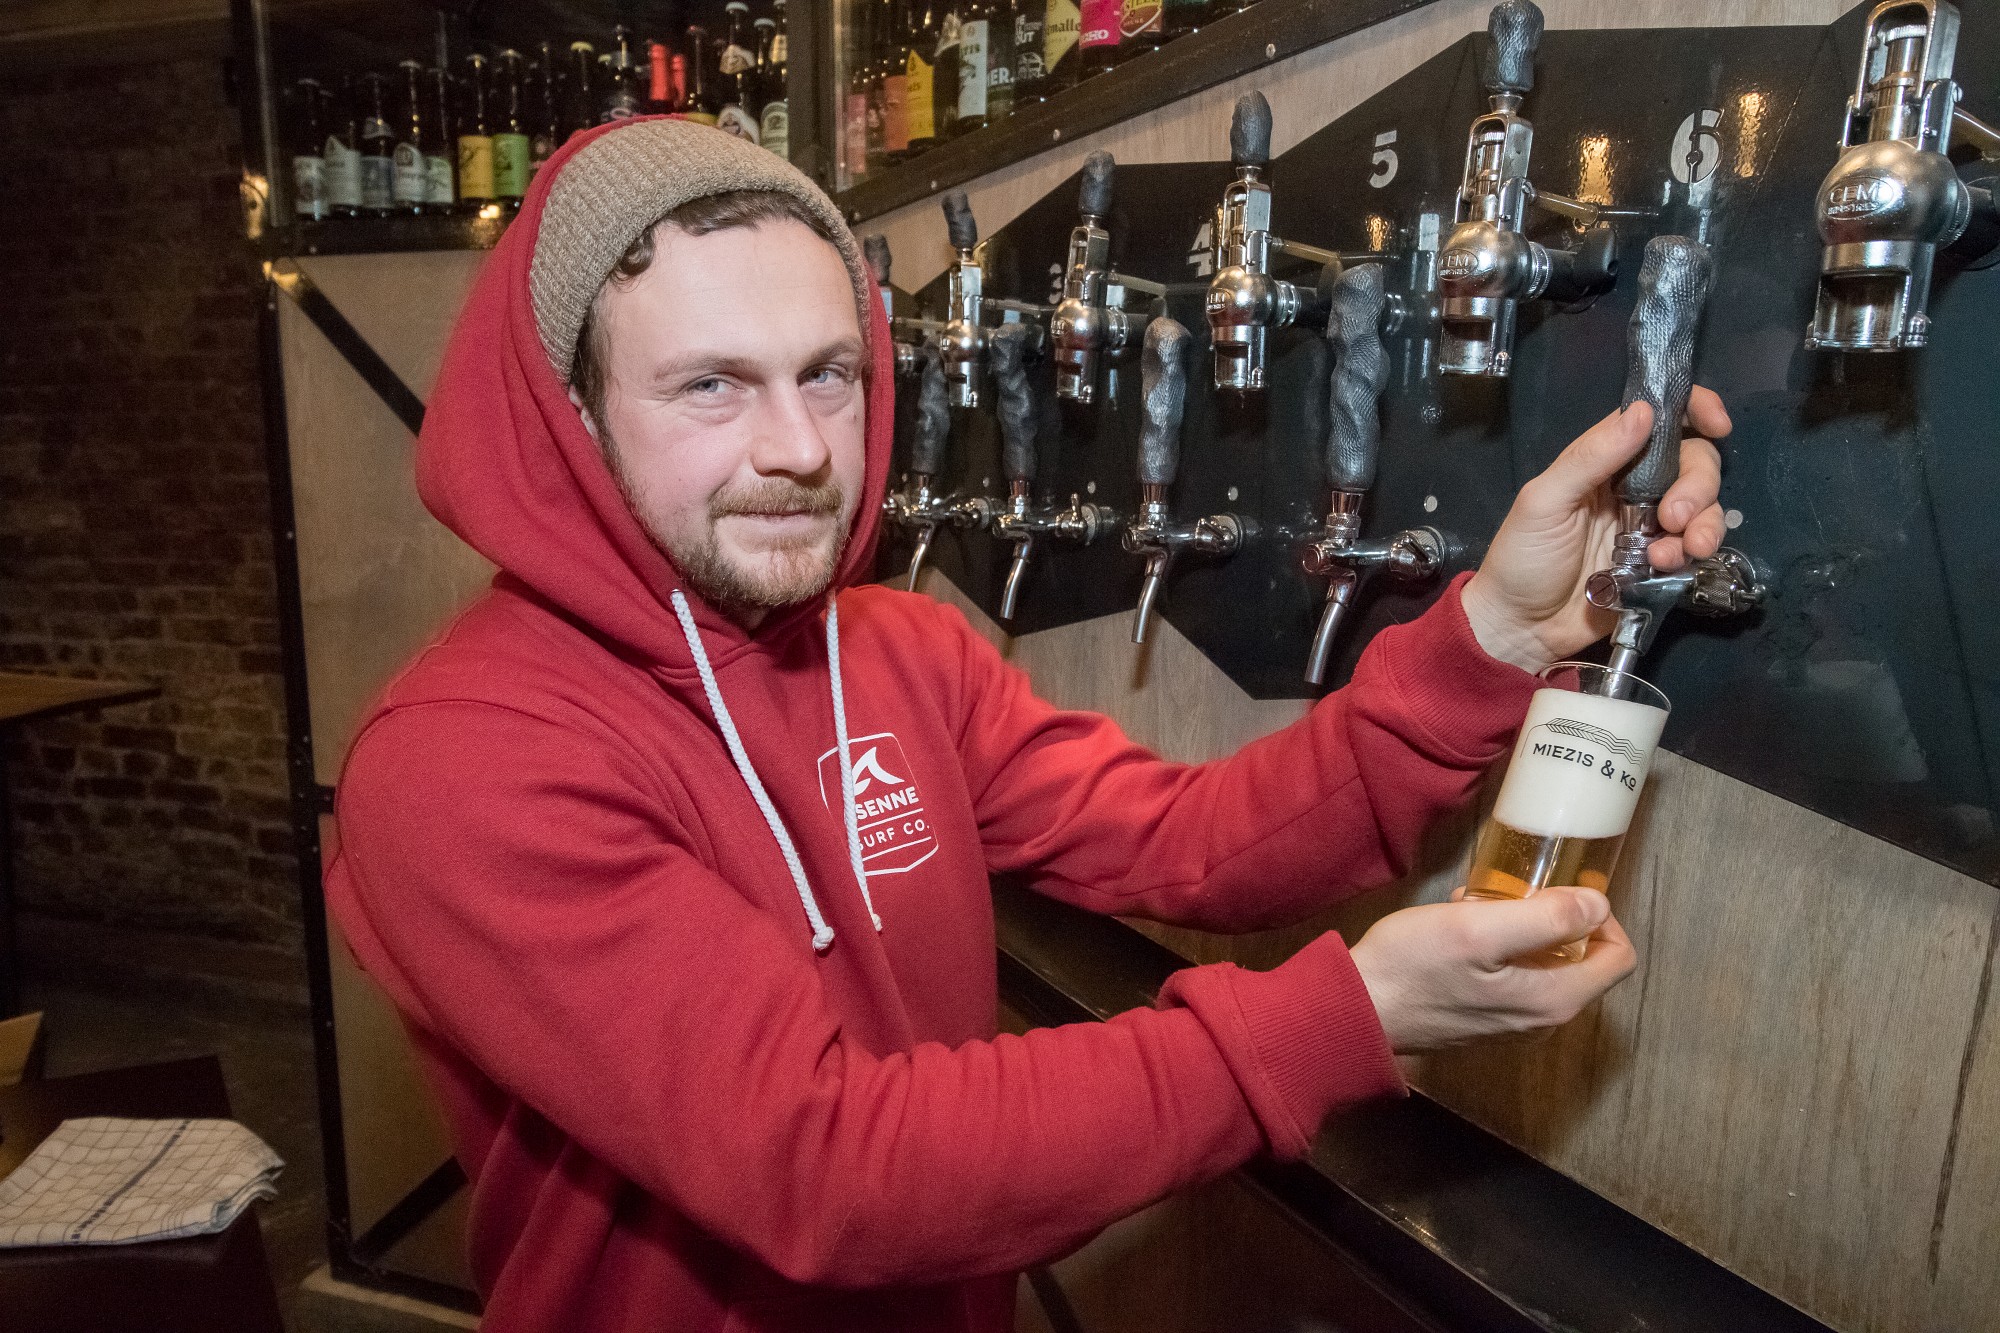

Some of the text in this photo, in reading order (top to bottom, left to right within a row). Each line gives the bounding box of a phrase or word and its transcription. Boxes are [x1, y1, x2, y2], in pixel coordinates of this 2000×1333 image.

[1369, 130, 1399, 188] 5
[1670, 108, 1725, 184] 6
[1830, 181, 1881, 203] CEM
[1187, 222, 1213, 278] 4
[1532, 743, 1595, 767] MIEZIS
[1600, 759, 1615, 779] &
[855, 786, 920, 820] SENNE
[903, 819, 930, 835] CO.
